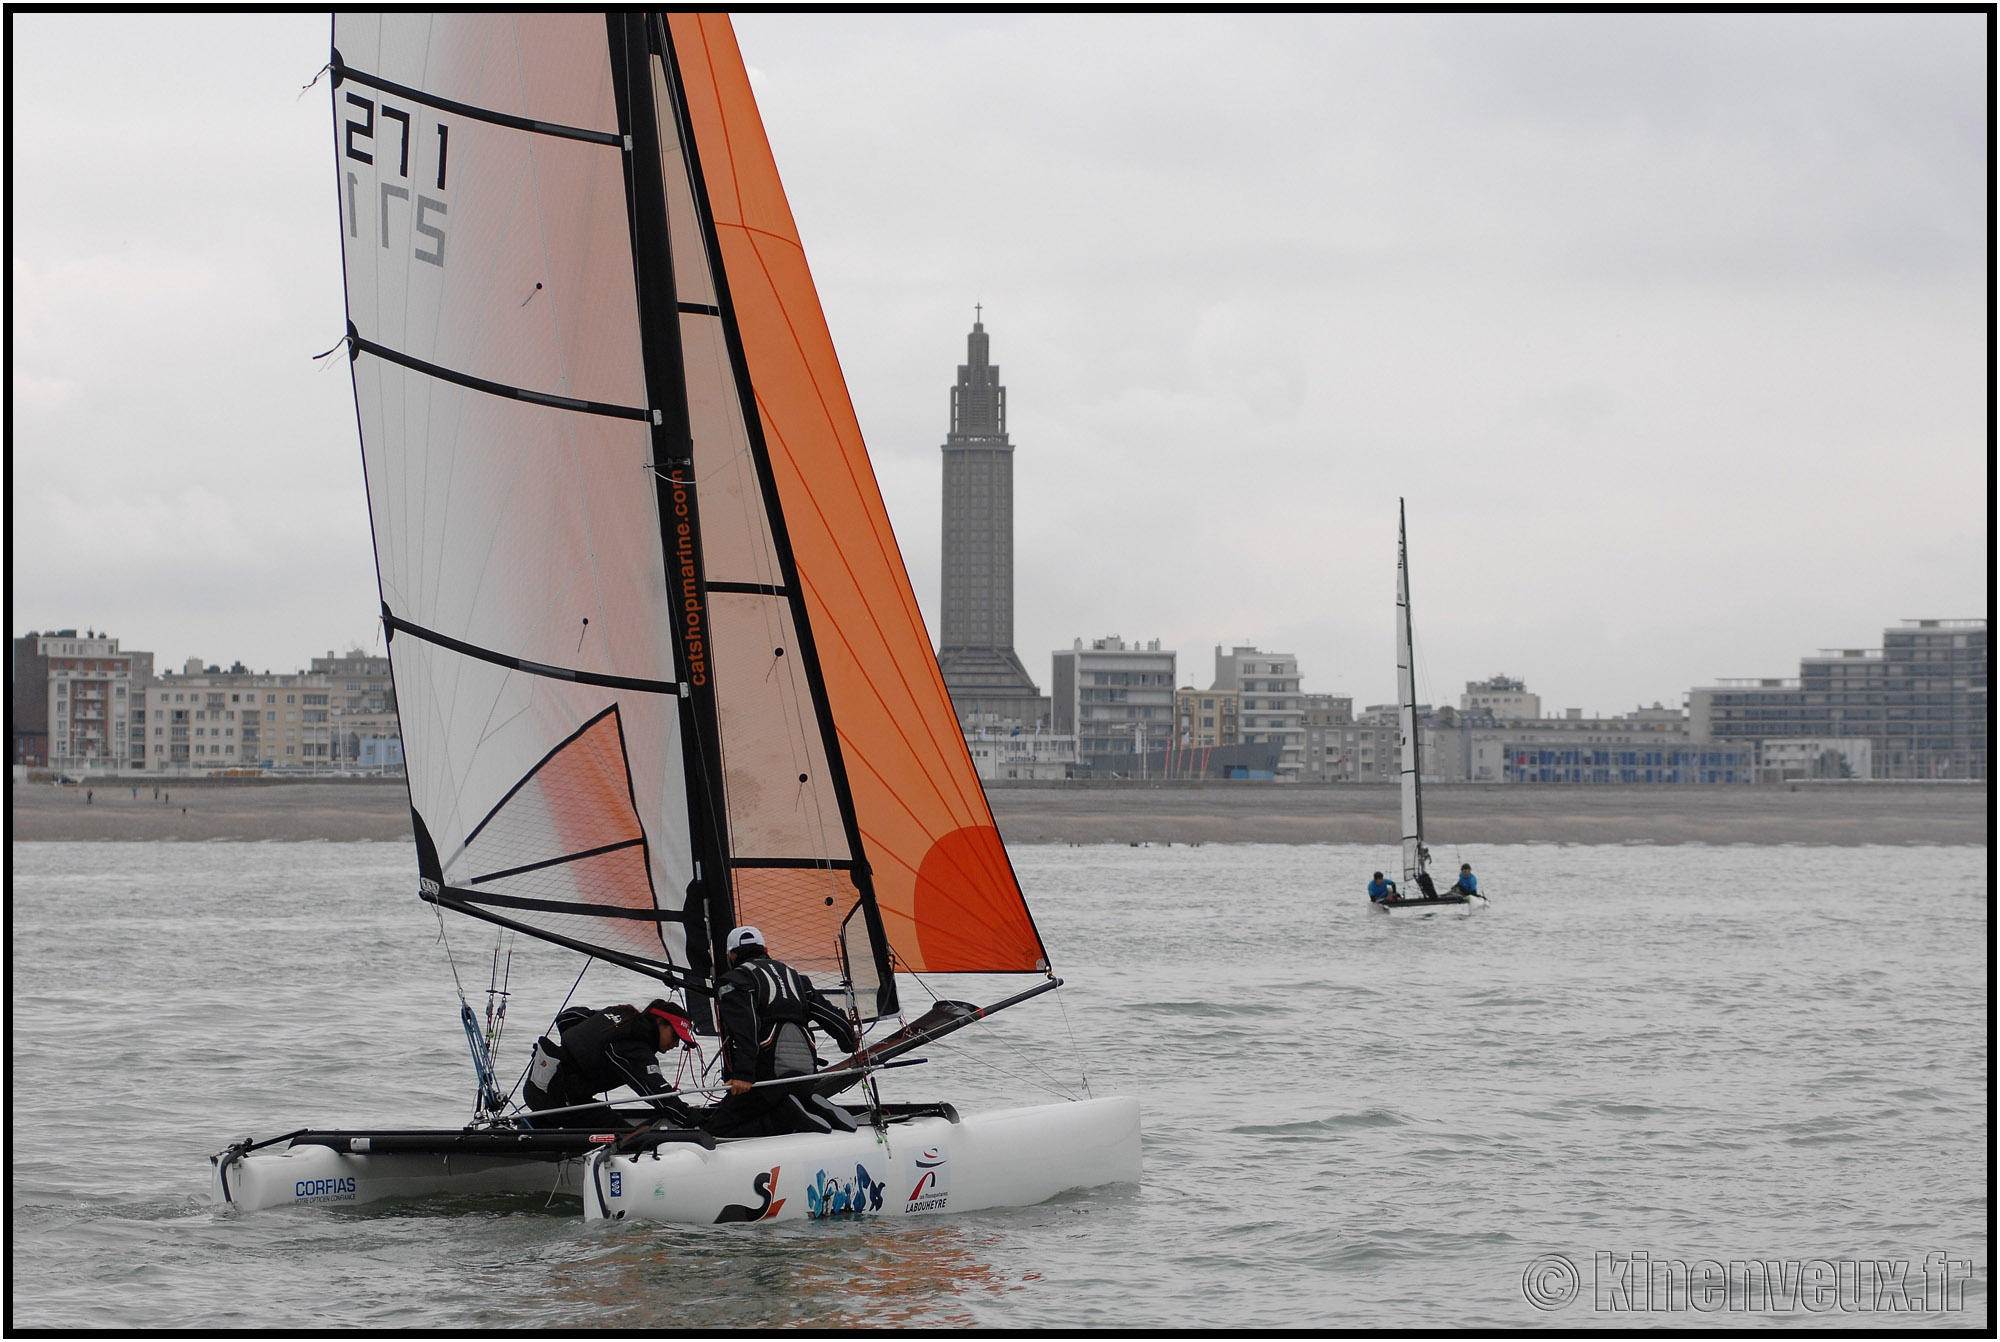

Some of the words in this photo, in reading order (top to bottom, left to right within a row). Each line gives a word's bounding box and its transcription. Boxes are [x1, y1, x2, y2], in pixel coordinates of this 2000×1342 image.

[346, 92, 448, 190] 271
[671, 468, 706, 687] catshopmarine.com
[296, 1177, 356, 1197] CORFIAS
[905, 1198, 947, 1213] LABOUHEYRE
